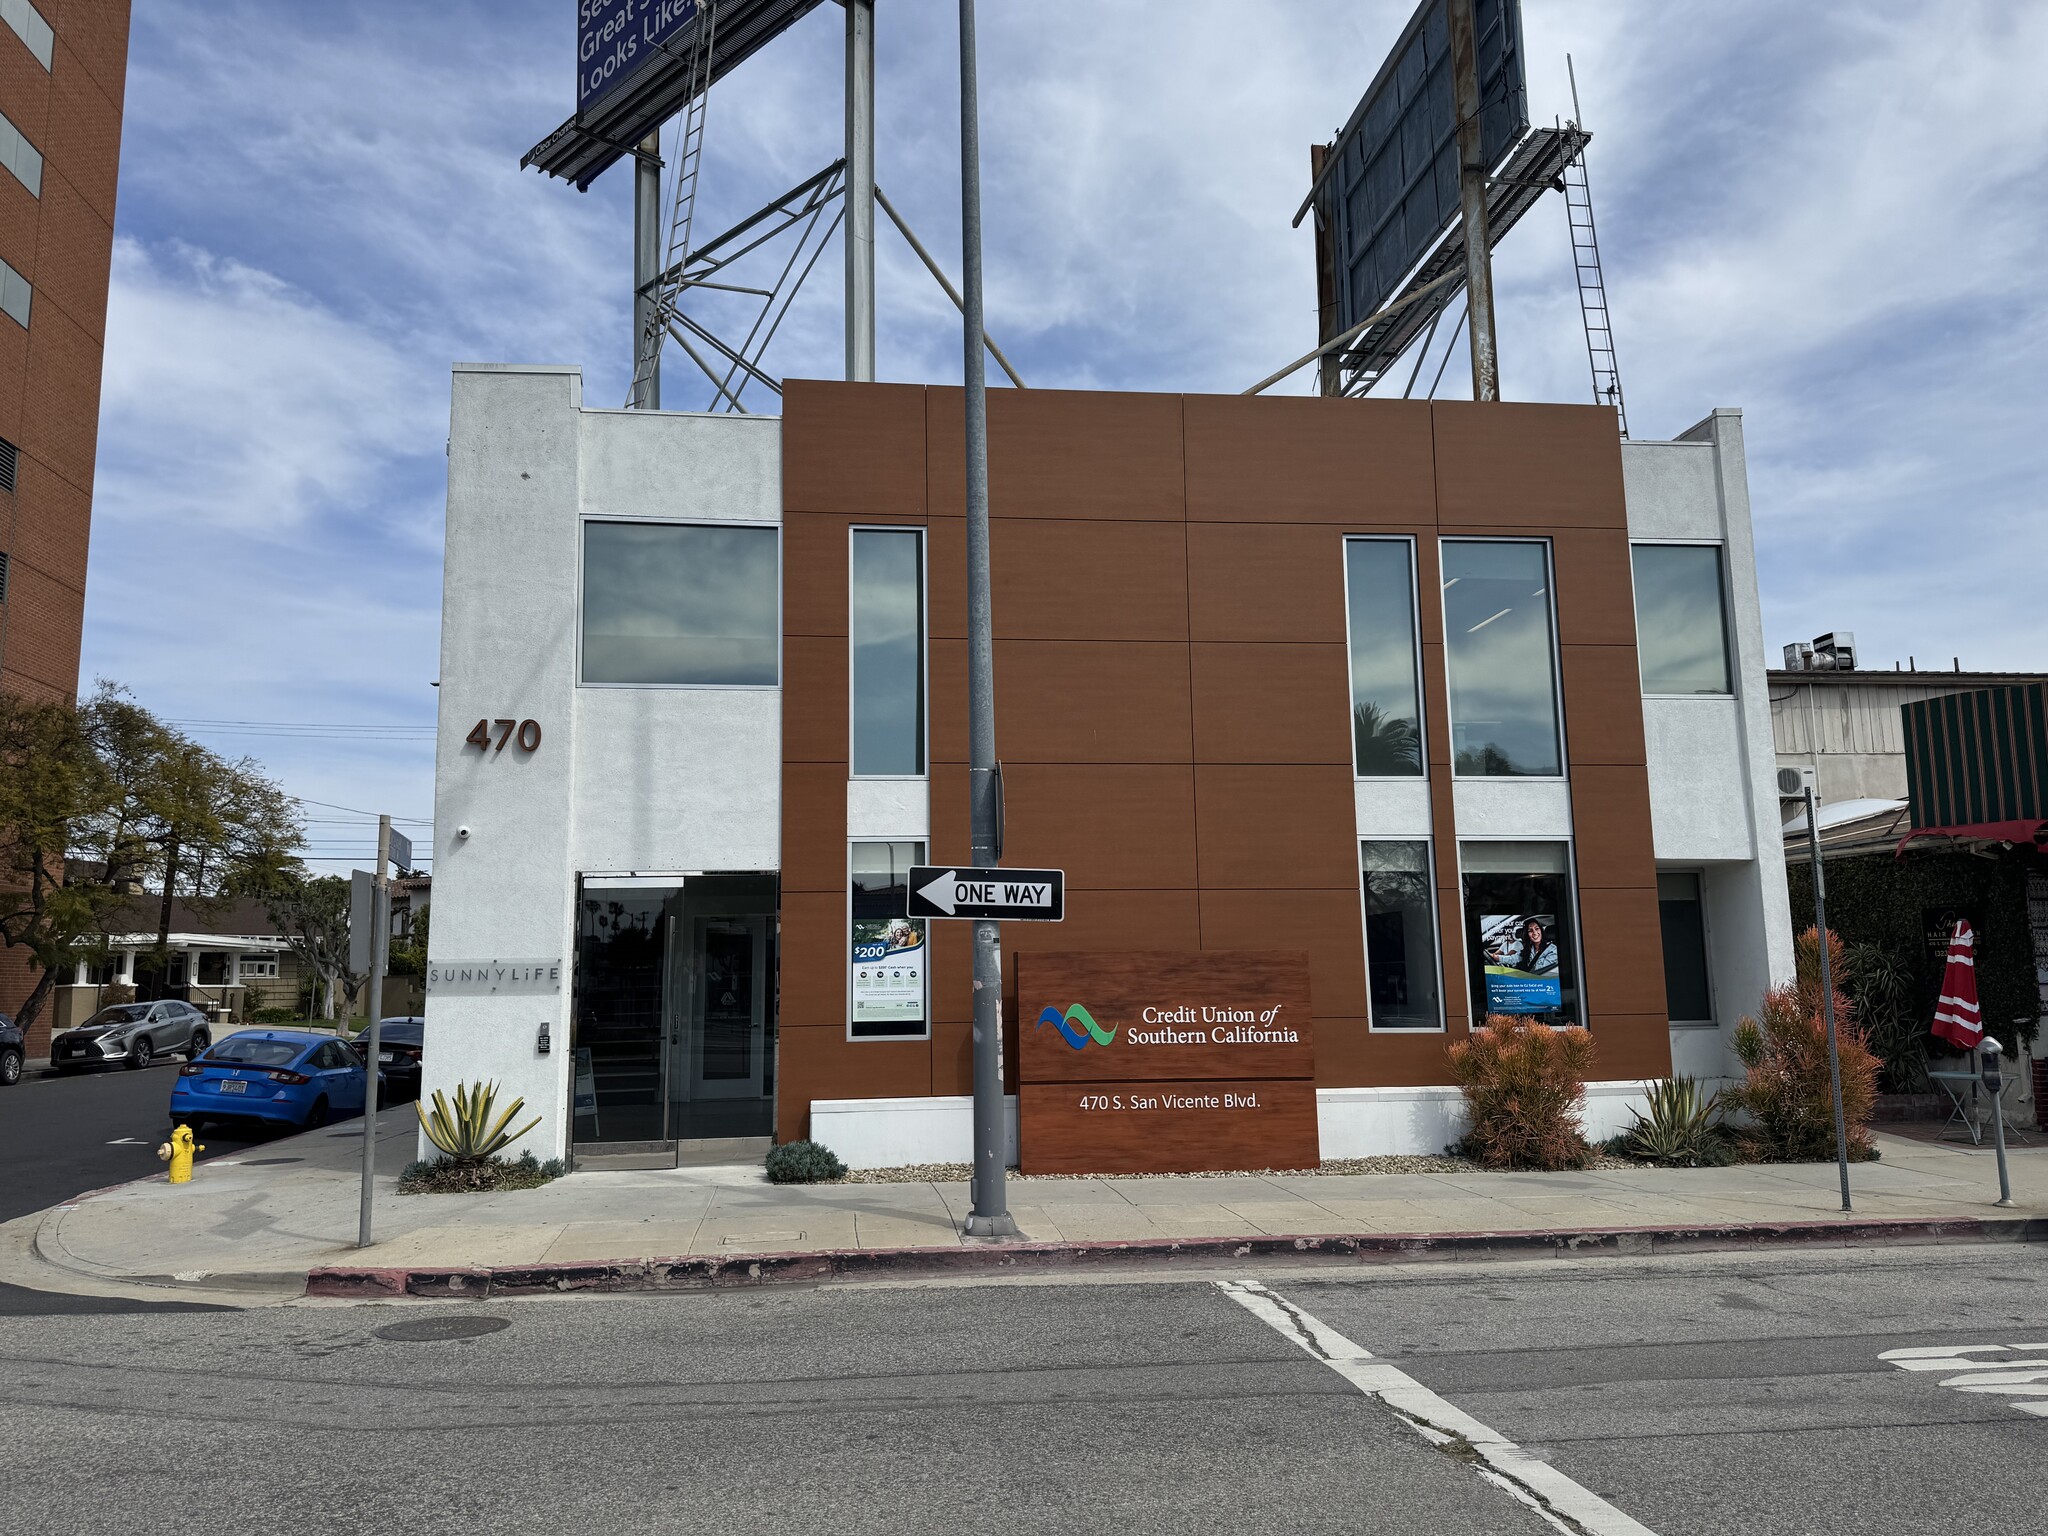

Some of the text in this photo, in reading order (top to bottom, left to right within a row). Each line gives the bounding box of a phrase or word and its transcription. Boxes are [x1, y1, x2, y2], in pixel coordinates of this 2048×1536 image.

[580, 0, 634, 62] Great
[580, 33, 637, 101] Looks
[466, 719, 542, 752] 470
[955, 883, 1046, 904] ONE WAY
[855, 946, 885, 958] $200
[1142, 1004, 1282, 1028] Credit Union of
[1127, 1025, 1299, 1044] Southern California
[1079, 1093, 1261, 1110] 470 S. San Vicente Blvd.
